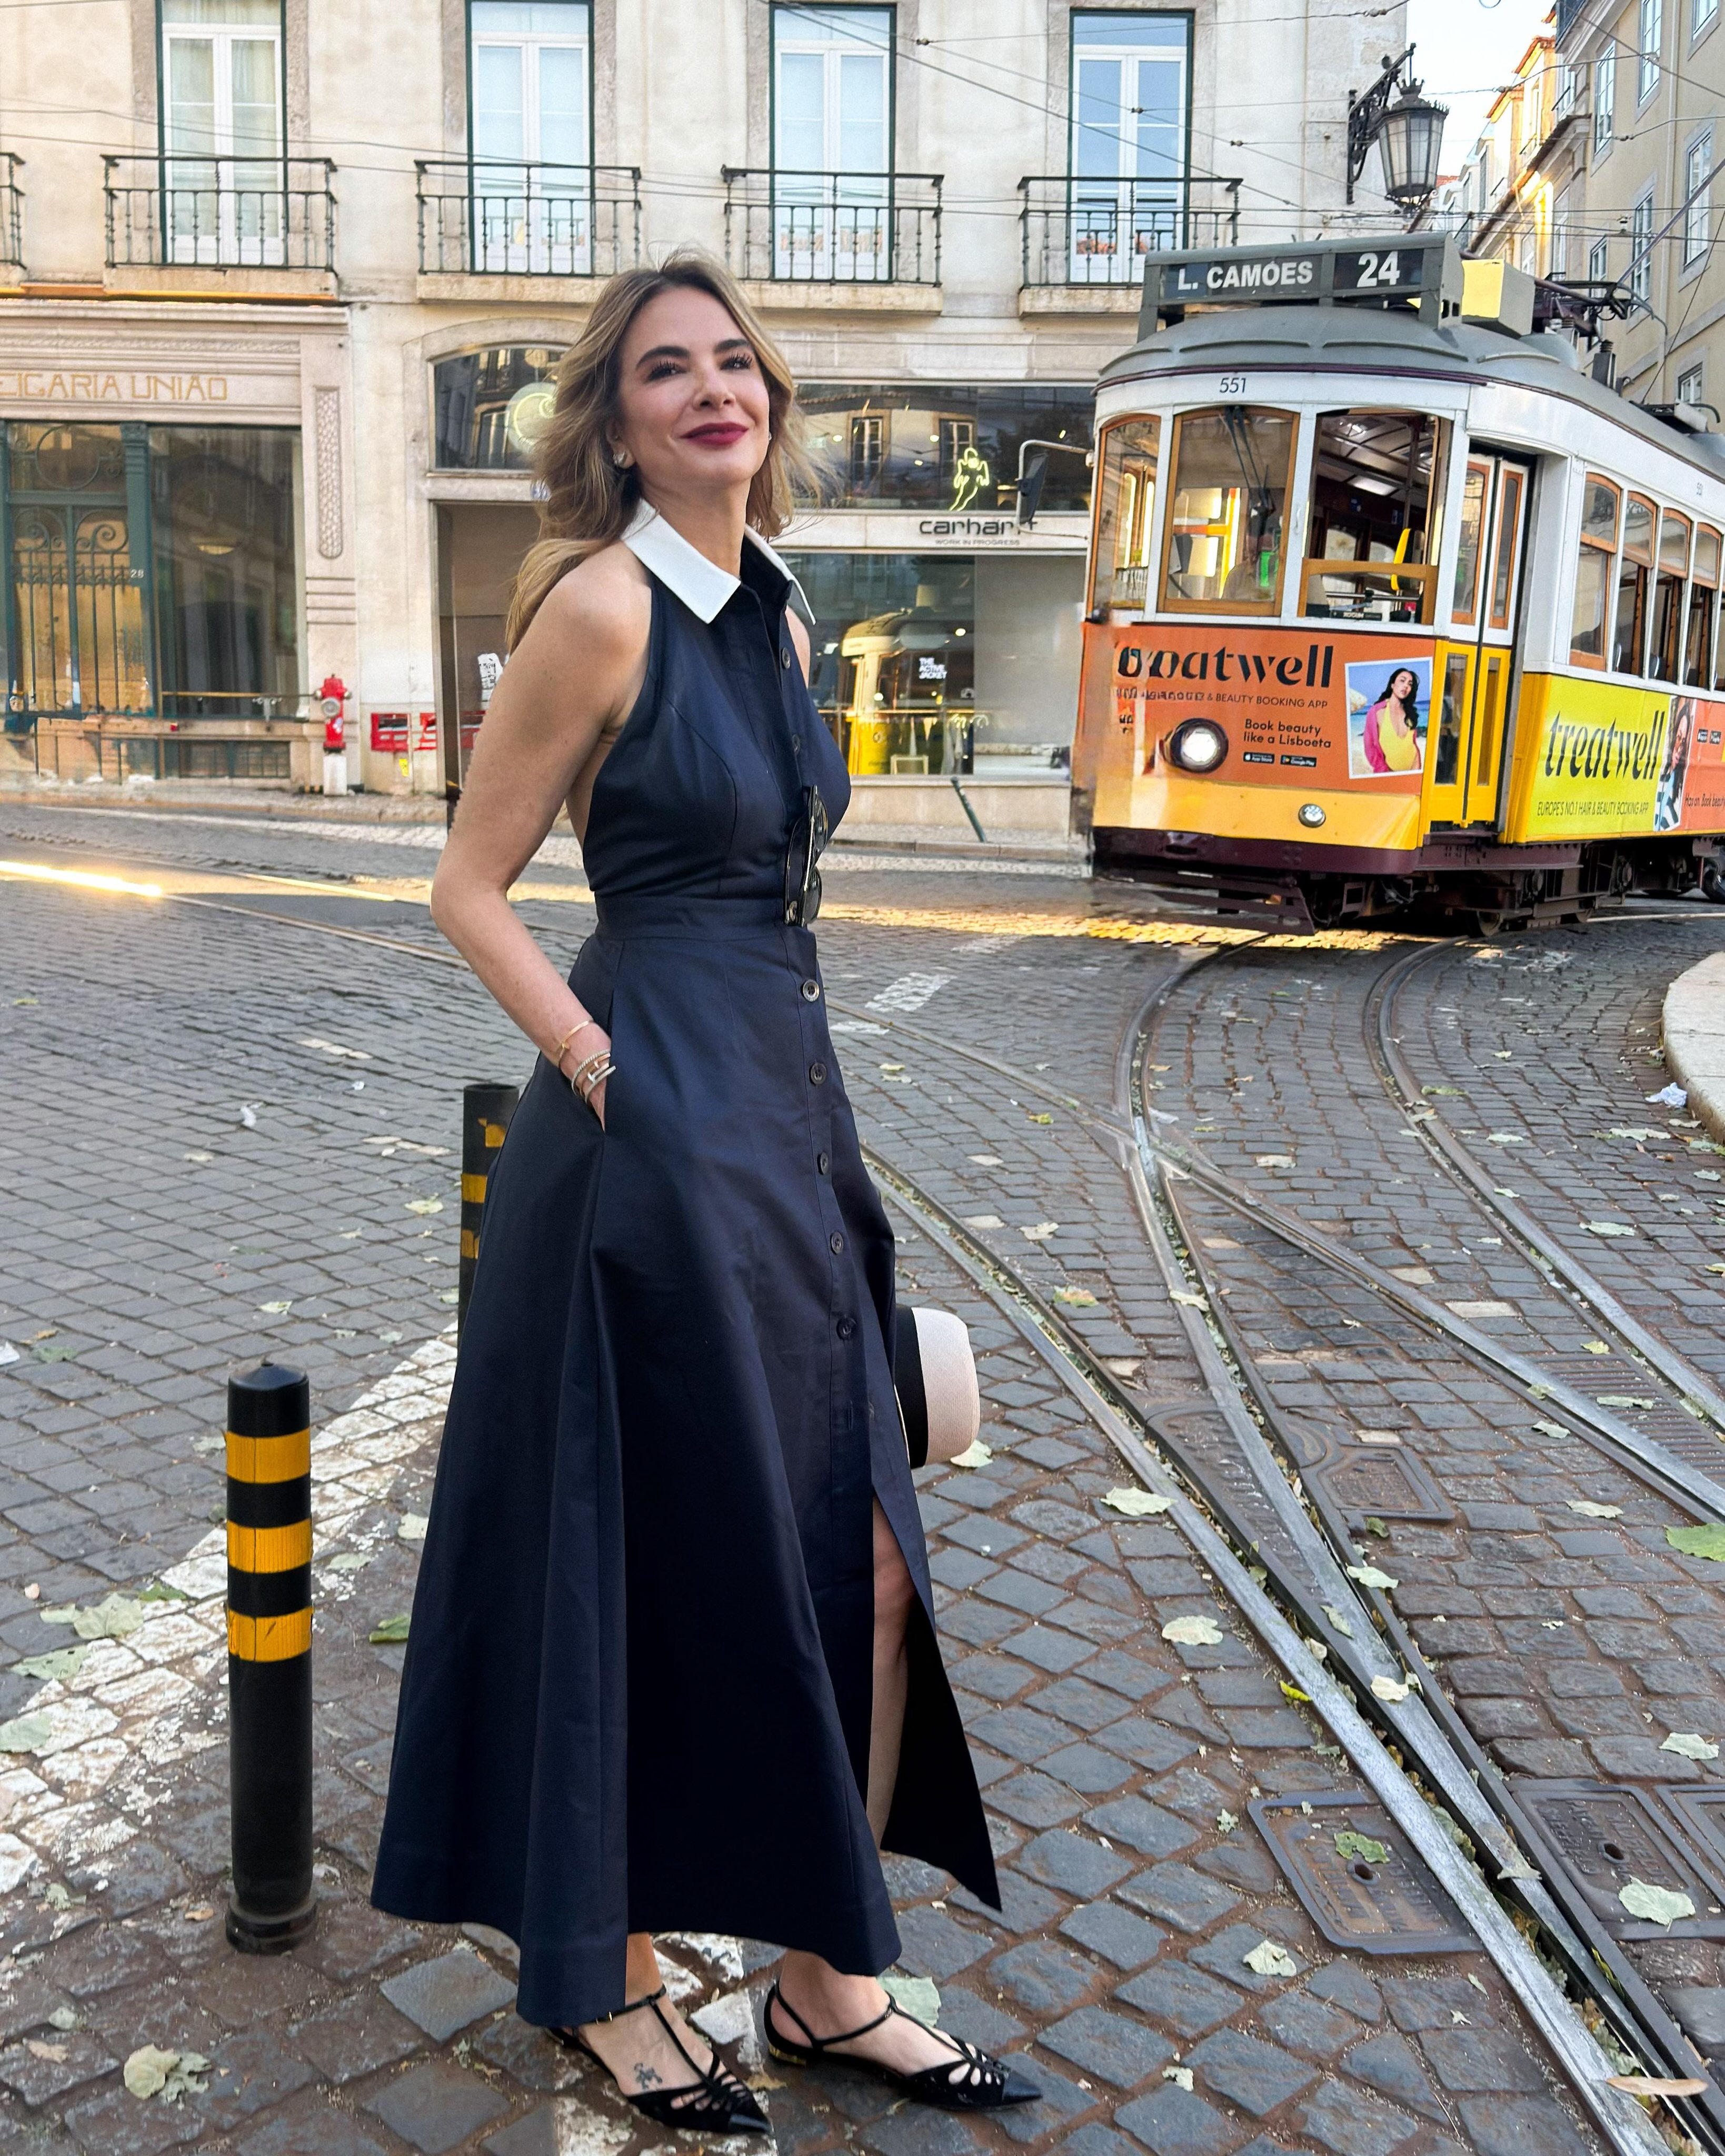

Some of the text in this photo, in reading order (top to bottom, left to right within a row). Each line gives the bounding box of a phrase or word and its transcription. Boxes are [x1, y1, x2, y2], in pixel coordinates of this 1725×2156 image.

[1357, 251, 1401, 288] 24
[1178, 268, 1199, 291] L.
[1220, 377, 1246, 393] 551
[919, 518, 1038, 535] carhart
[131, 568, 144, 578] 28
[1216, 693, 1254, 704] BEAUTY
[1256, 696, 1305, 708] BOOKING
[1308, 700, 1328, 709] APP
[1245, 718, 1321, 737] Book beauty
[1243, 731, 1264, 743] like
[1279, 734, 1331, 748] Lisboeta
[1545, 710, 1665, 780] treatwell
[1537, 801, 1564, 816] EUROPE'S
[1579, 802, 1592, 816] HAIR
[1596, 802, 1617, 816] BEAUTY
[1617, 802, 1639, 815] BOOKING
[1639, 802, 1649, 815] APP
